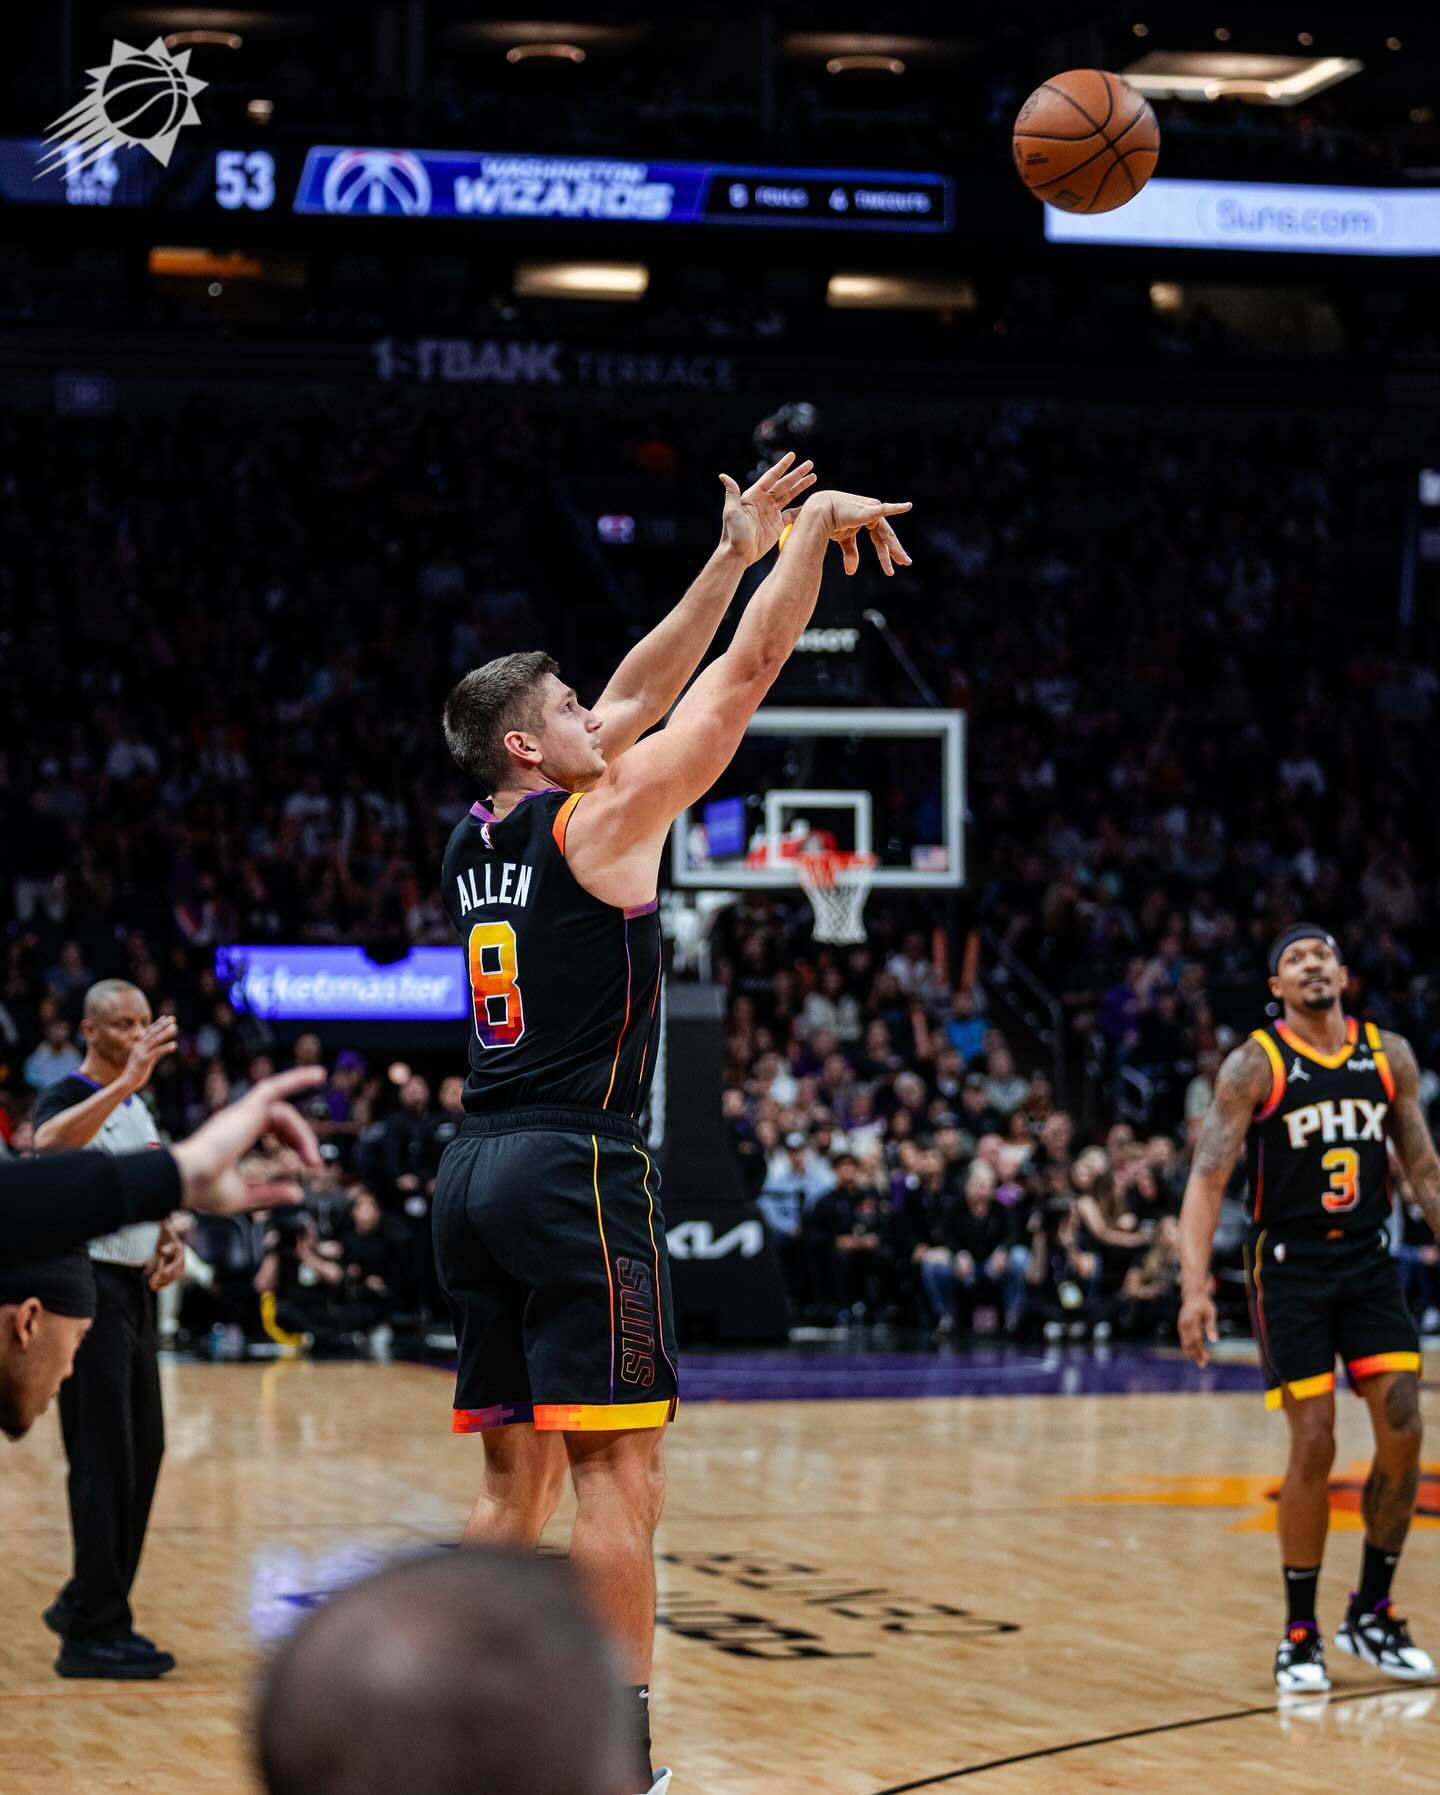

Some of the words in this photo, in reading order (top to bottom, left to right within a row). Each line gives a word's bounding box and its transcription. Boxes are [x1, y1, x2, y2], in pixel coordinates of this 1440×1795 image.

[215, 149, 275, 210] 53
[481, 158, 648, 183] WASHINGTON
[455, 177, 675, 220] WIZARDS
[1214, 196, 1378, 237] Suns.com
[456, 861, 533, 917] ALLEN
[232, 965, 455, 1001] icketmaster
[468, 920, 525, 1049] 8
[1283, 1099, 1388, 1150] PHX
[1320, 1146, 1360, 1214] 3
[616, 1256, 655, 1388] SUNS
